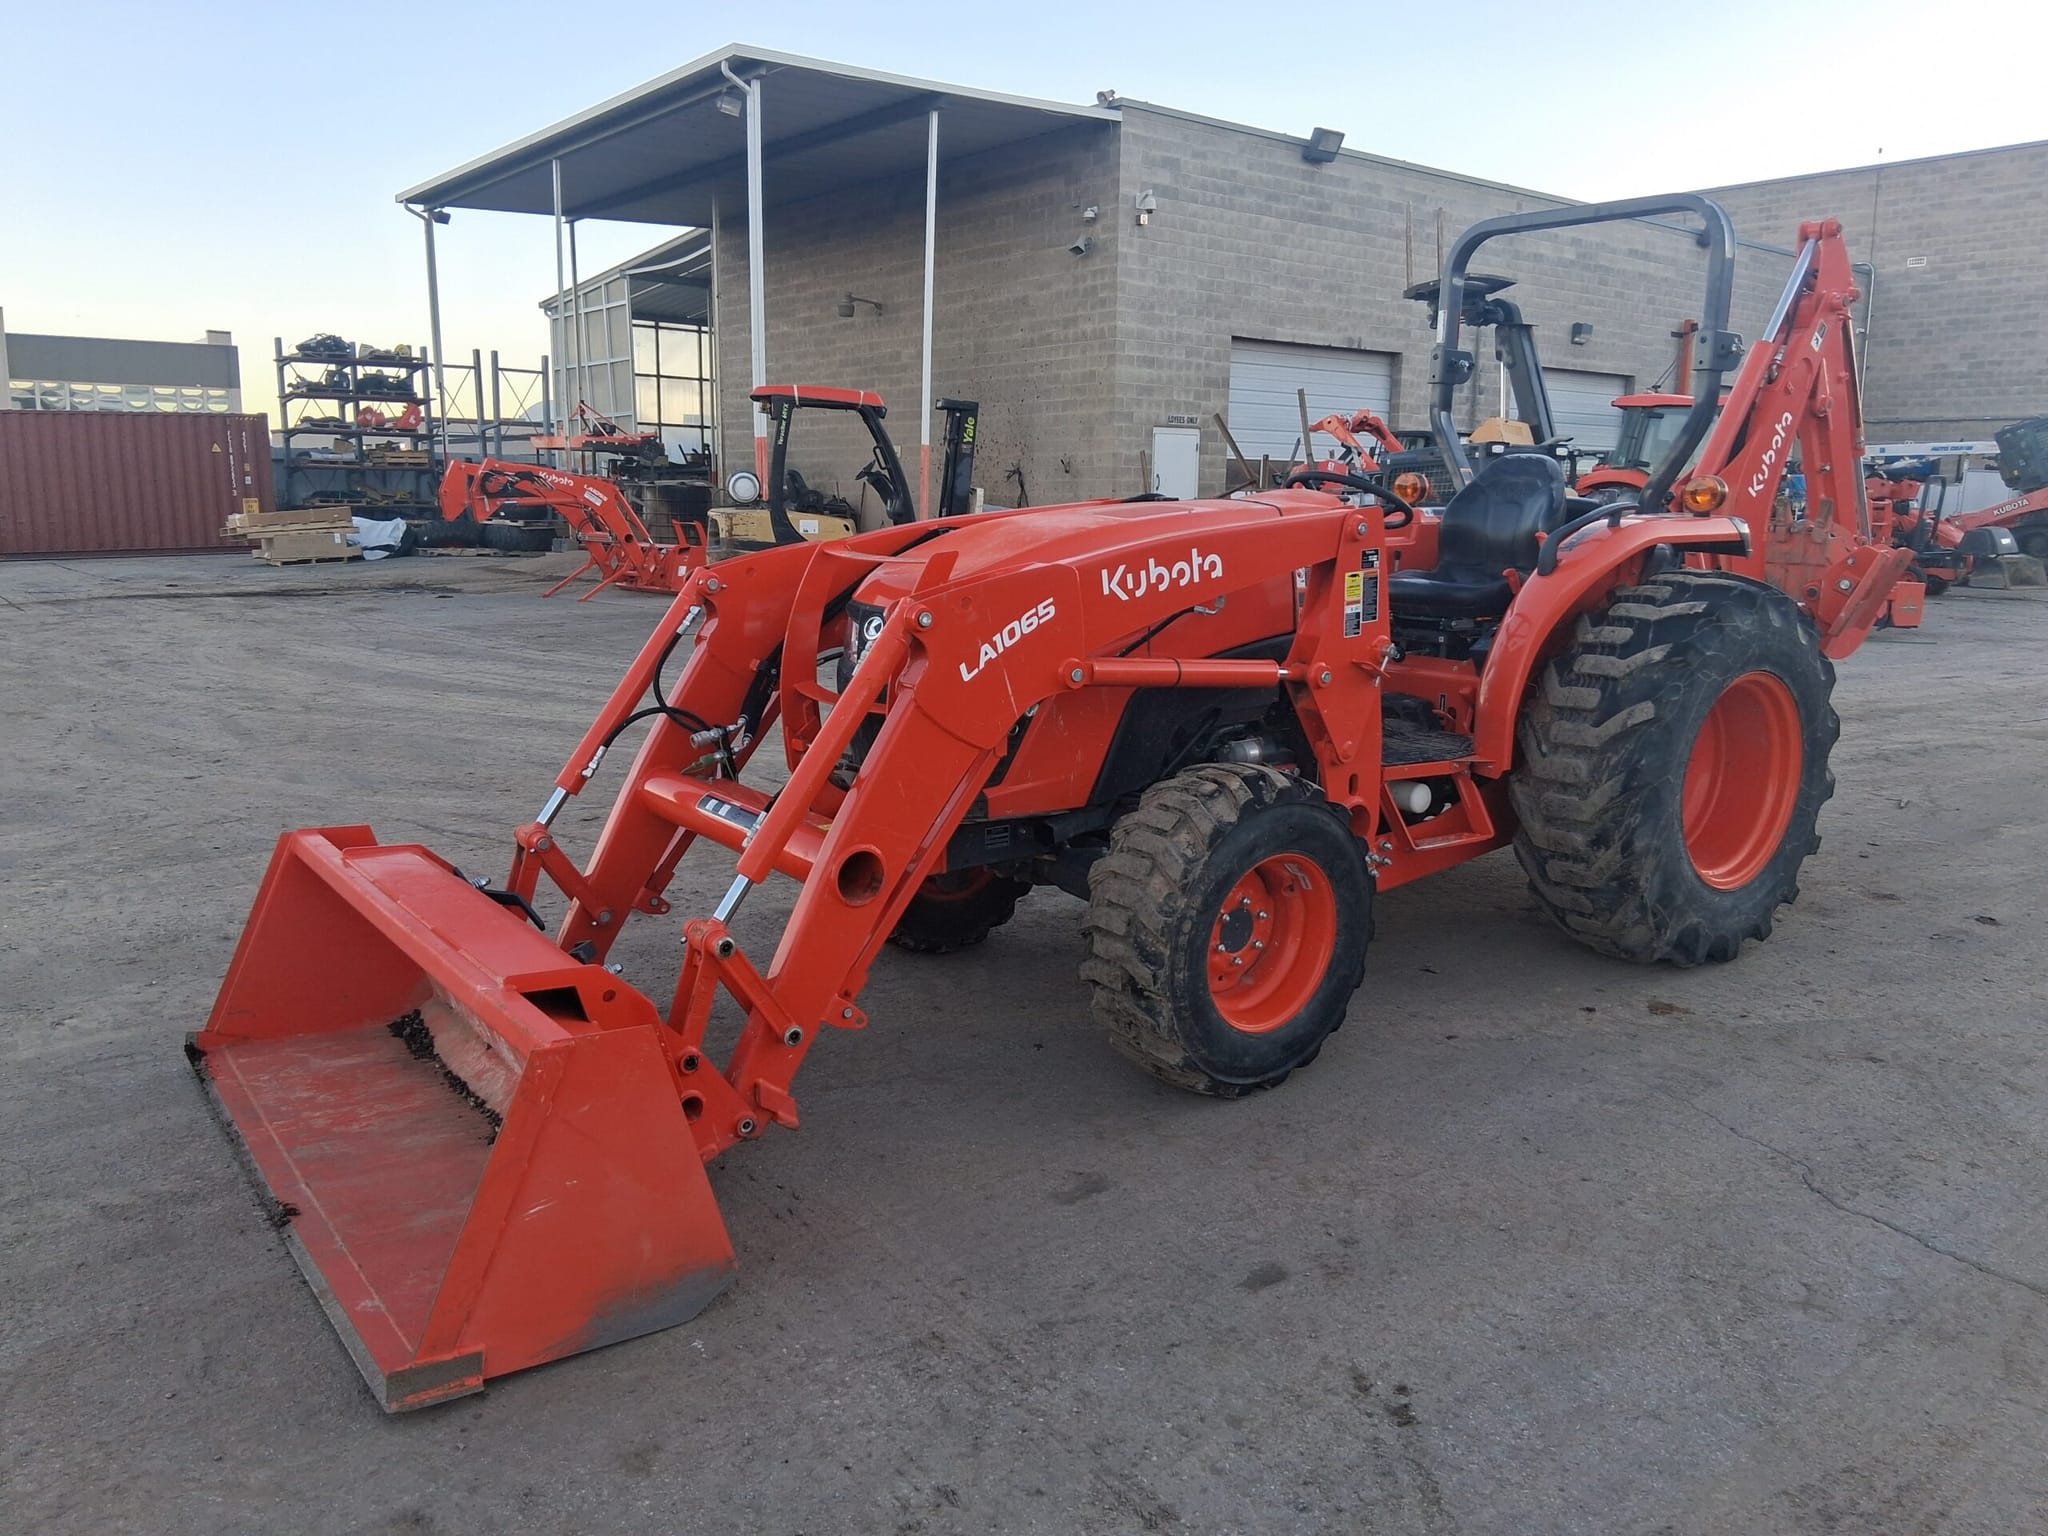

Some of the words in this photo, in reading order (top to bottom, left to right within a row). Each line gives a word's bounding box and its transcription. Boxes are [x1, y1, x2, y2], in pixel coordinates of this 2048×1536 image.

[963, 416, 975, 442] Yale
[1748, 412, 1792, 497] Kubota
[538, 471, 574, 487] Kubota
[1993, 499, 2030, 516] KUBOTA
[1101, 548, 1223, 601] Kubota
[959, 597, 1057, 682] LA1065
